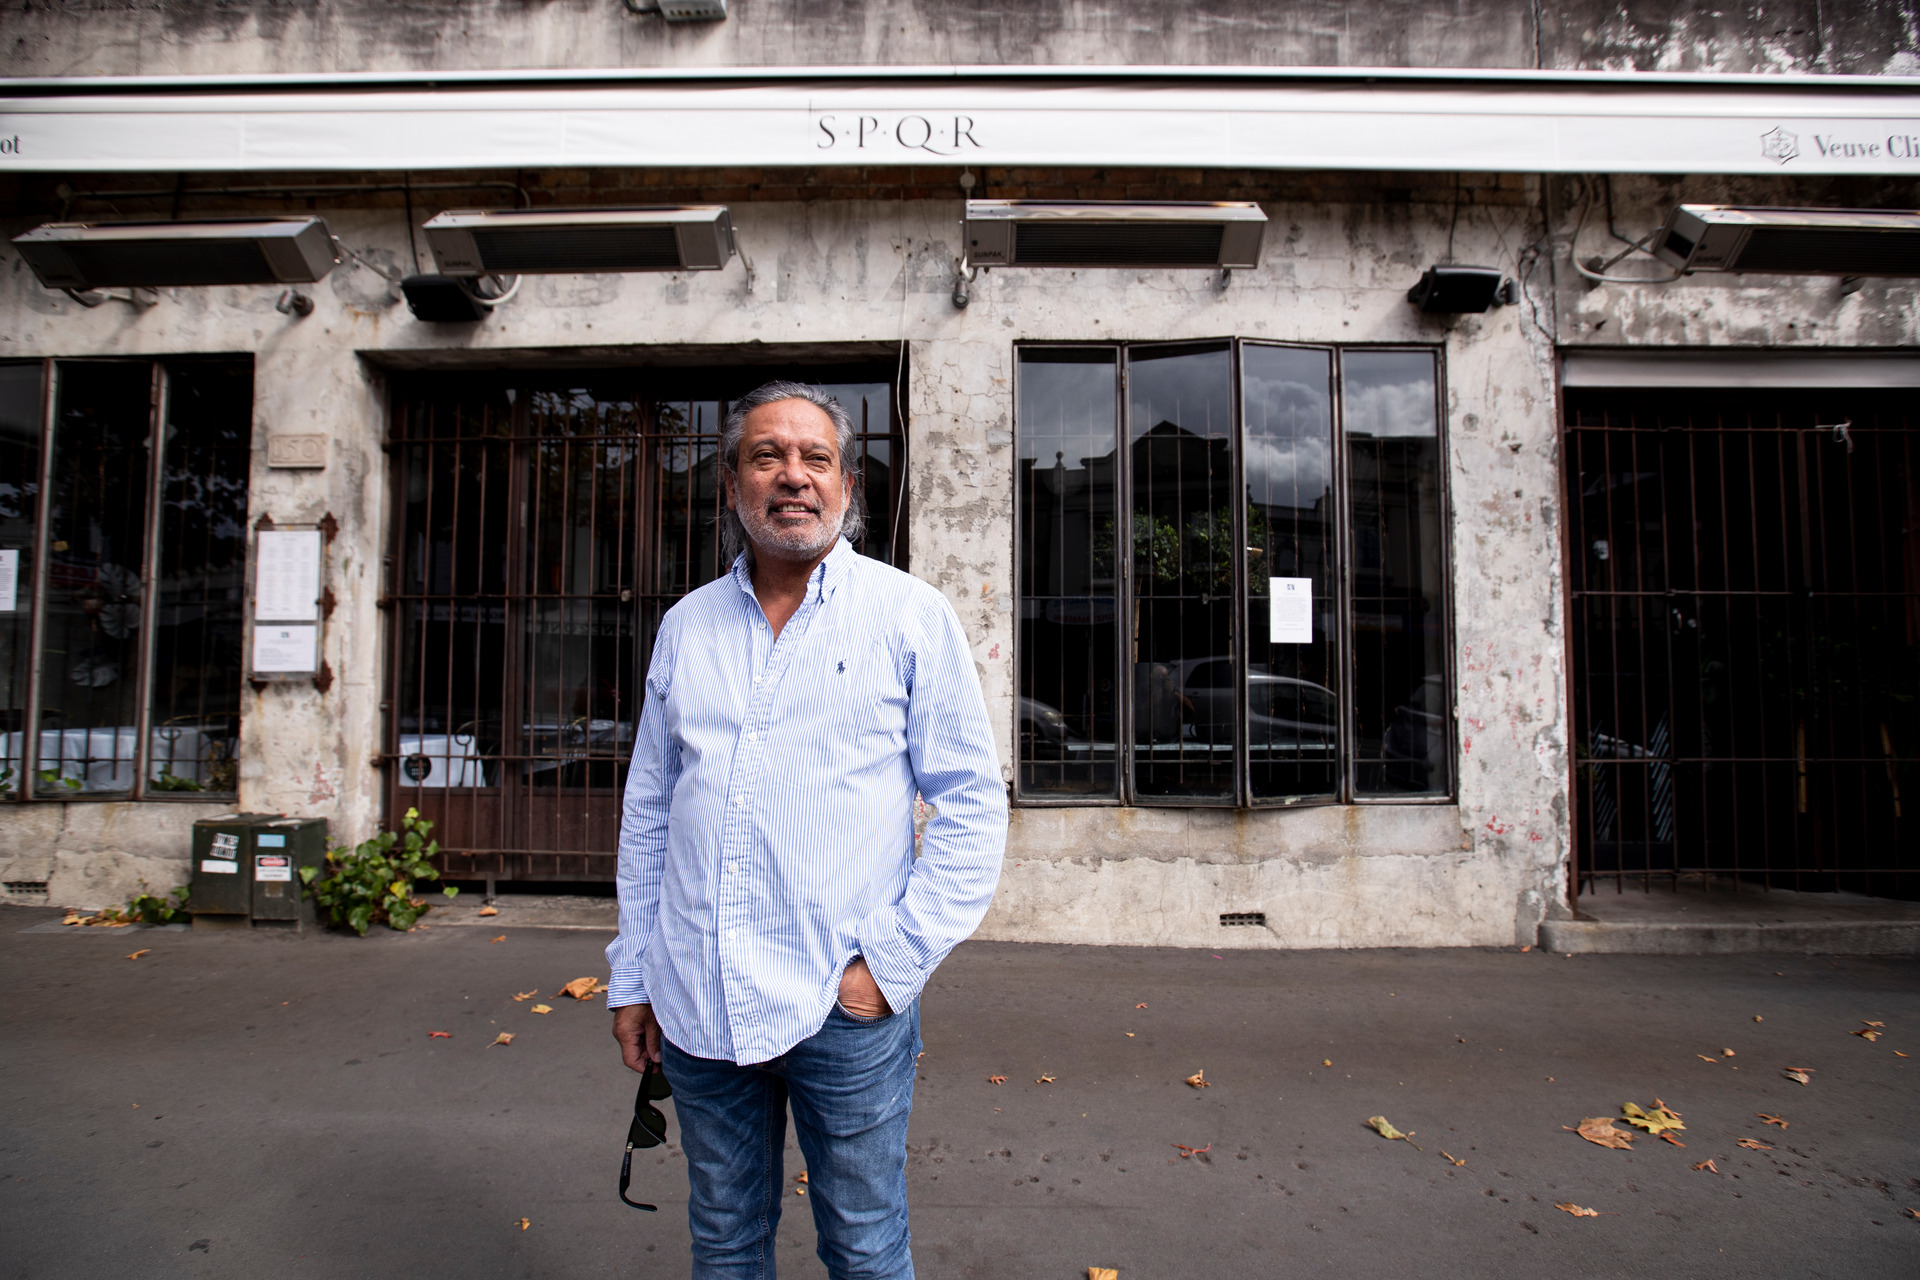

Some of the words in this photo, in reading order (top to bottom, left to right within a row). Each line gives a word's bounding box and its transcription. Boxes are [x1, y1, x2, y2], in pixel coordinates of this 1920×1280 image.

[1812, 134, 1881, 158] Veuve
[1888, 134, 1920, 158] Cli
[272, 438, 320, 460] 150
